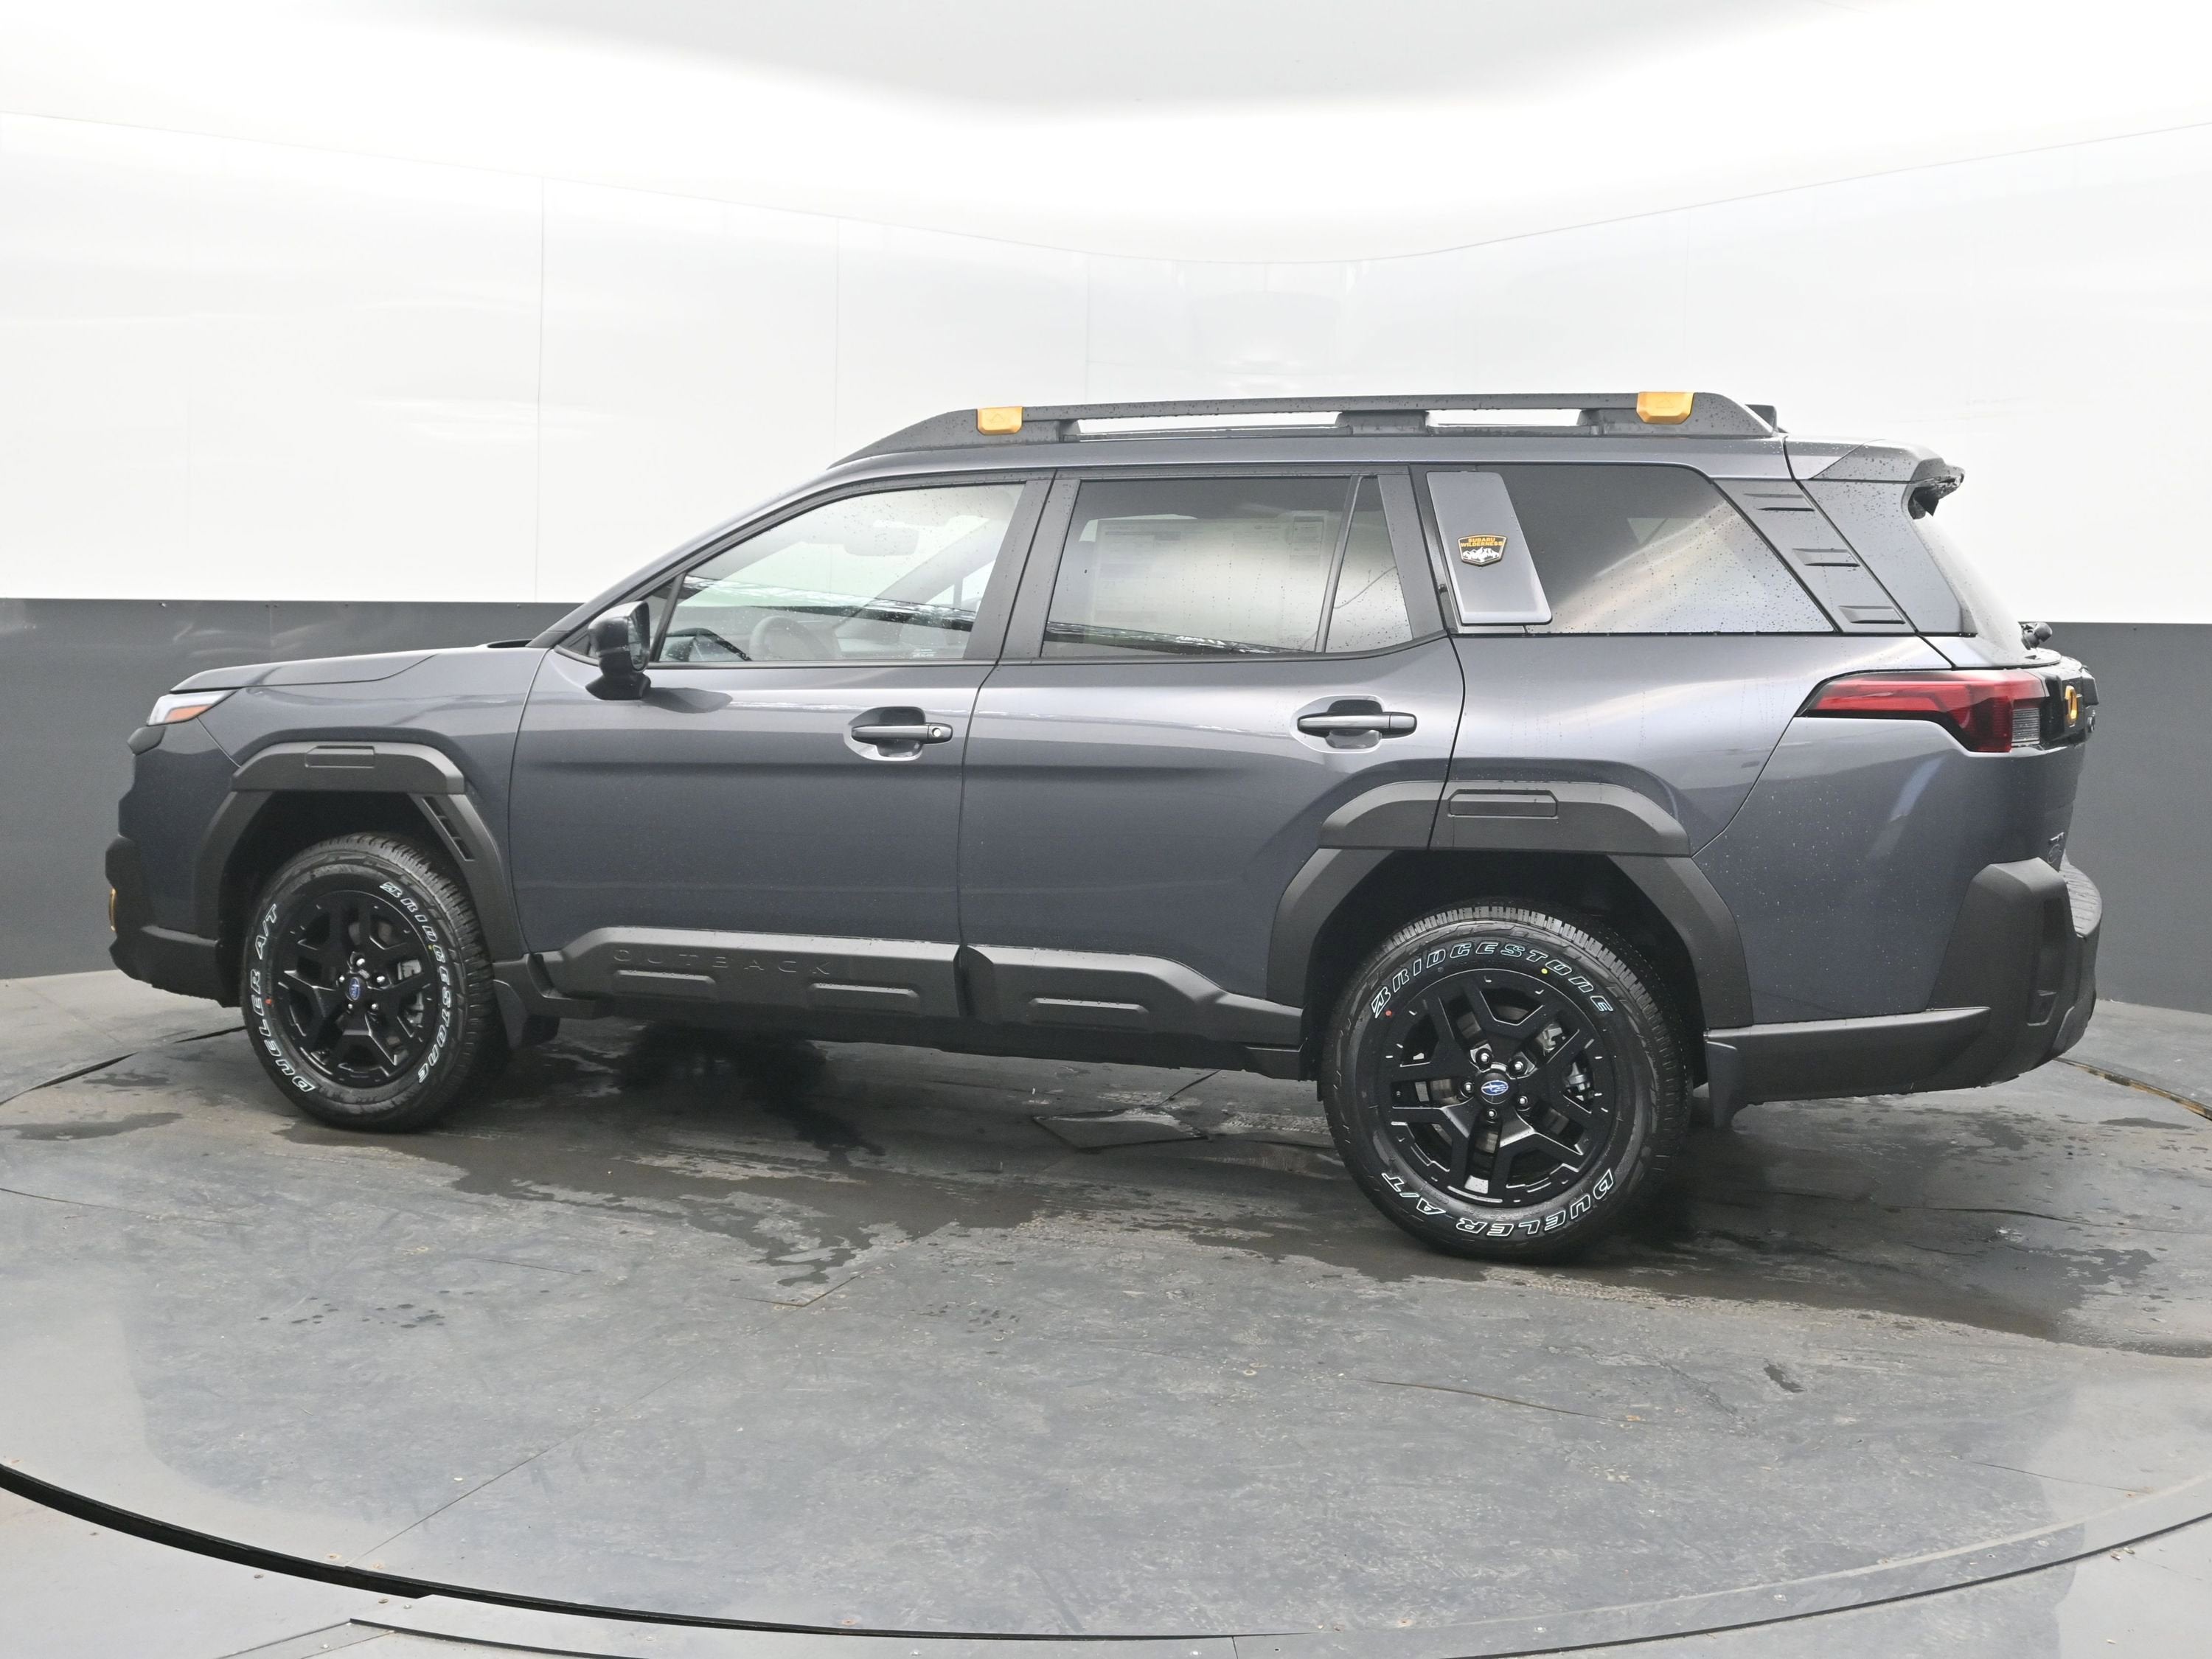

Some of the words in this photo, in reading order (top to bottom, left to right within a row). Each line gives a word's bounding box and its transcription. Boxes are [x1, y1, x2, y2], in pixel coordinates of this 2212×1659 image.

[254, 903, 278, 960] A/T
[612, 949, 832, 975] OUTBACK
[379, 881, 452, 1083] BRIDGESTONE
[1370, 941, 1614, 1019] BRIDGESTONE
[250, 968, 316, 1093] DUELER
[1380, 1171, 1447, 1215] A/T
[1455, 1168, 1615, 1237] DUELER
